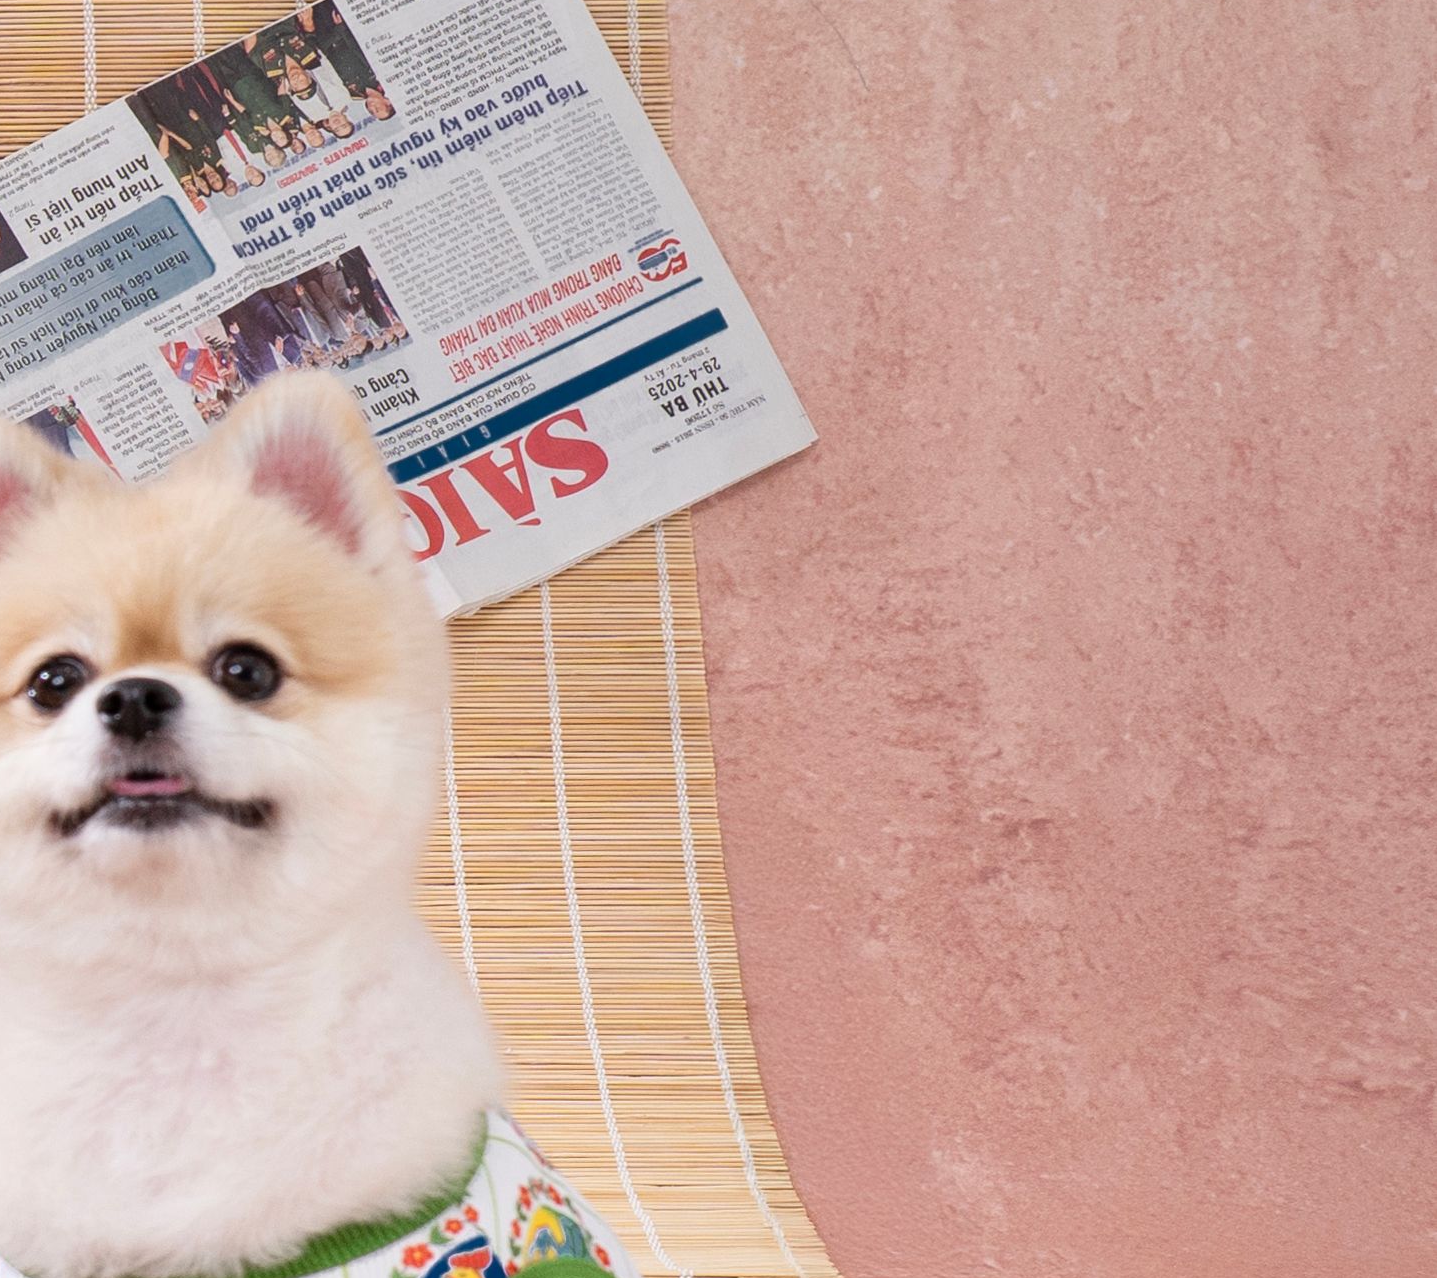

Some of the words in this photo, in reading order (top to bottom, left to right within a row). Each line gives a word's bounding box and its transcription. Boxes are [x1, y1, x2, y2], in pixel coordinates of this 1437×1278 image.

[119, 174, 163, 202] Thắp
[85, 197, 116, 221] nến
[39, 227, 61, 245] ân
[63, 215, 85, 235] tri
[648, 357, 721, 400] 29-4-2025
[692, 376, 729, 406] THỨ
[661, 395, 689, 417] BA
